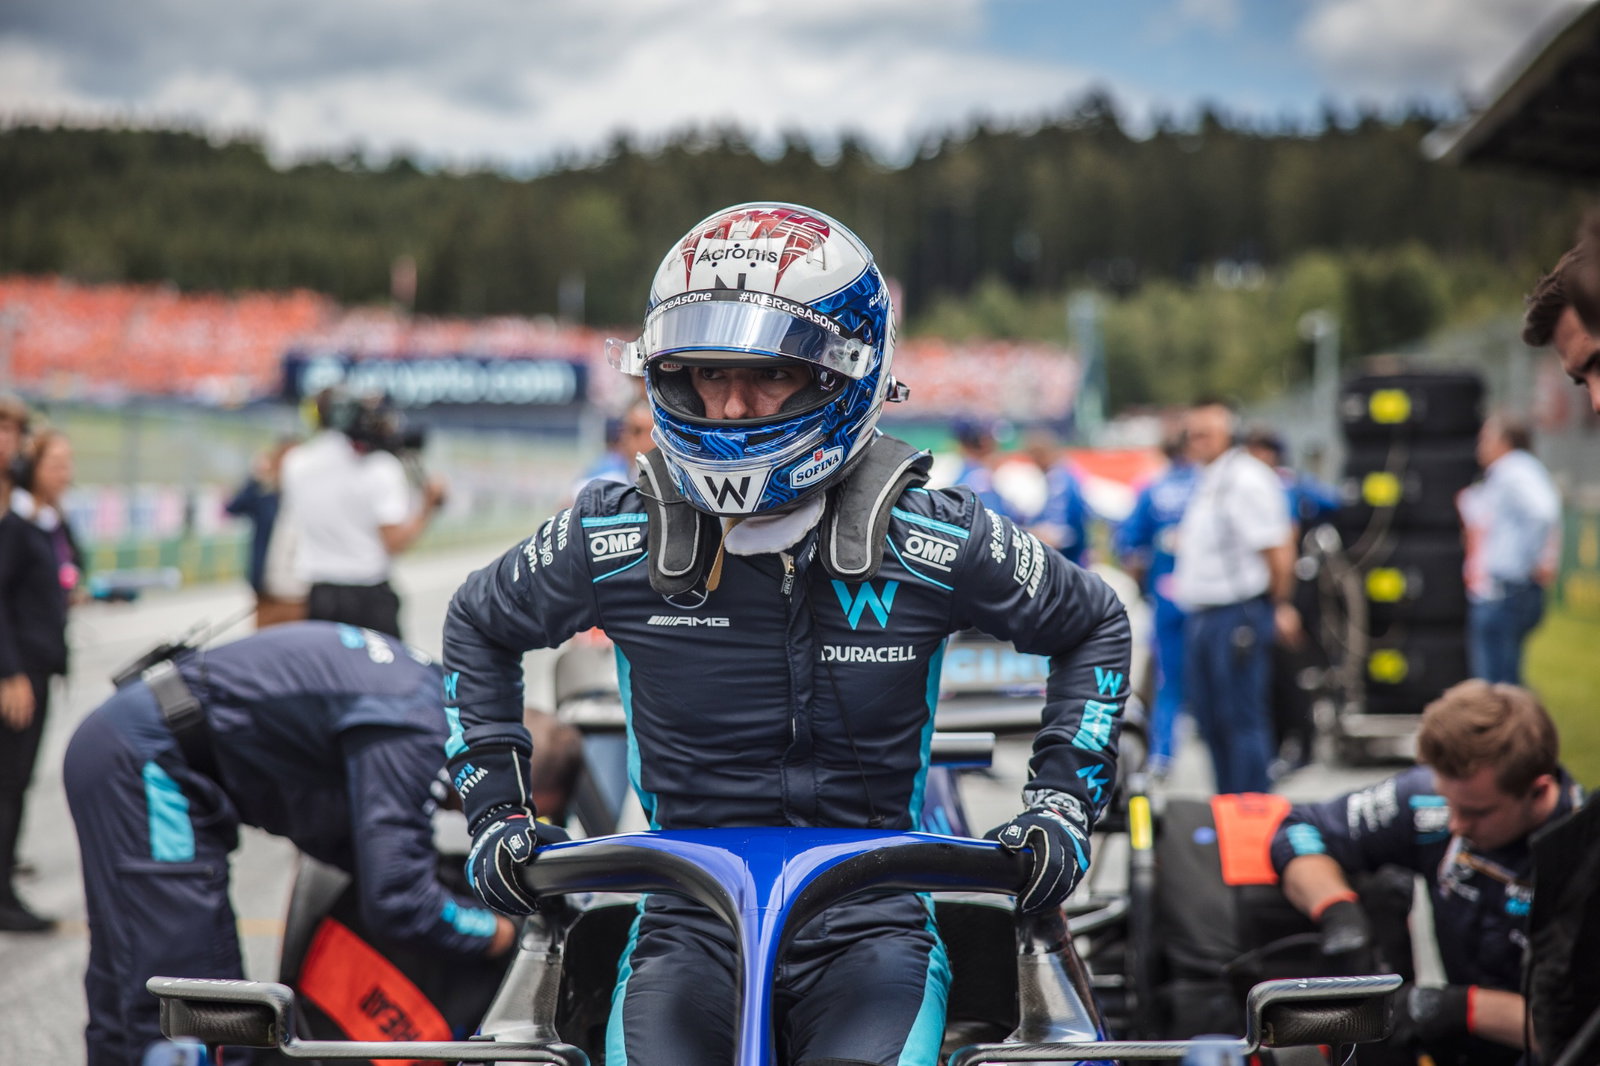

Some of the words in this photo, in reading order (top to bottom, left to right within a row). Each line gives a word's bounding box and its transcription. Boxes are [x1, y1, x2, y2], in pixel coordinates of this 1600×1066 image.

[695, 247, 778, 265] Acronis
[739, 292, 840, 334] #WeRaceAsOne
[796, 454, 840, 483] SOFINA
[703, 475, 752, 510] W
[590, 530, 642, 557] OMP
[904, 535, 957, 566] OMP
[821, 645, 916, 662] DURACELL
